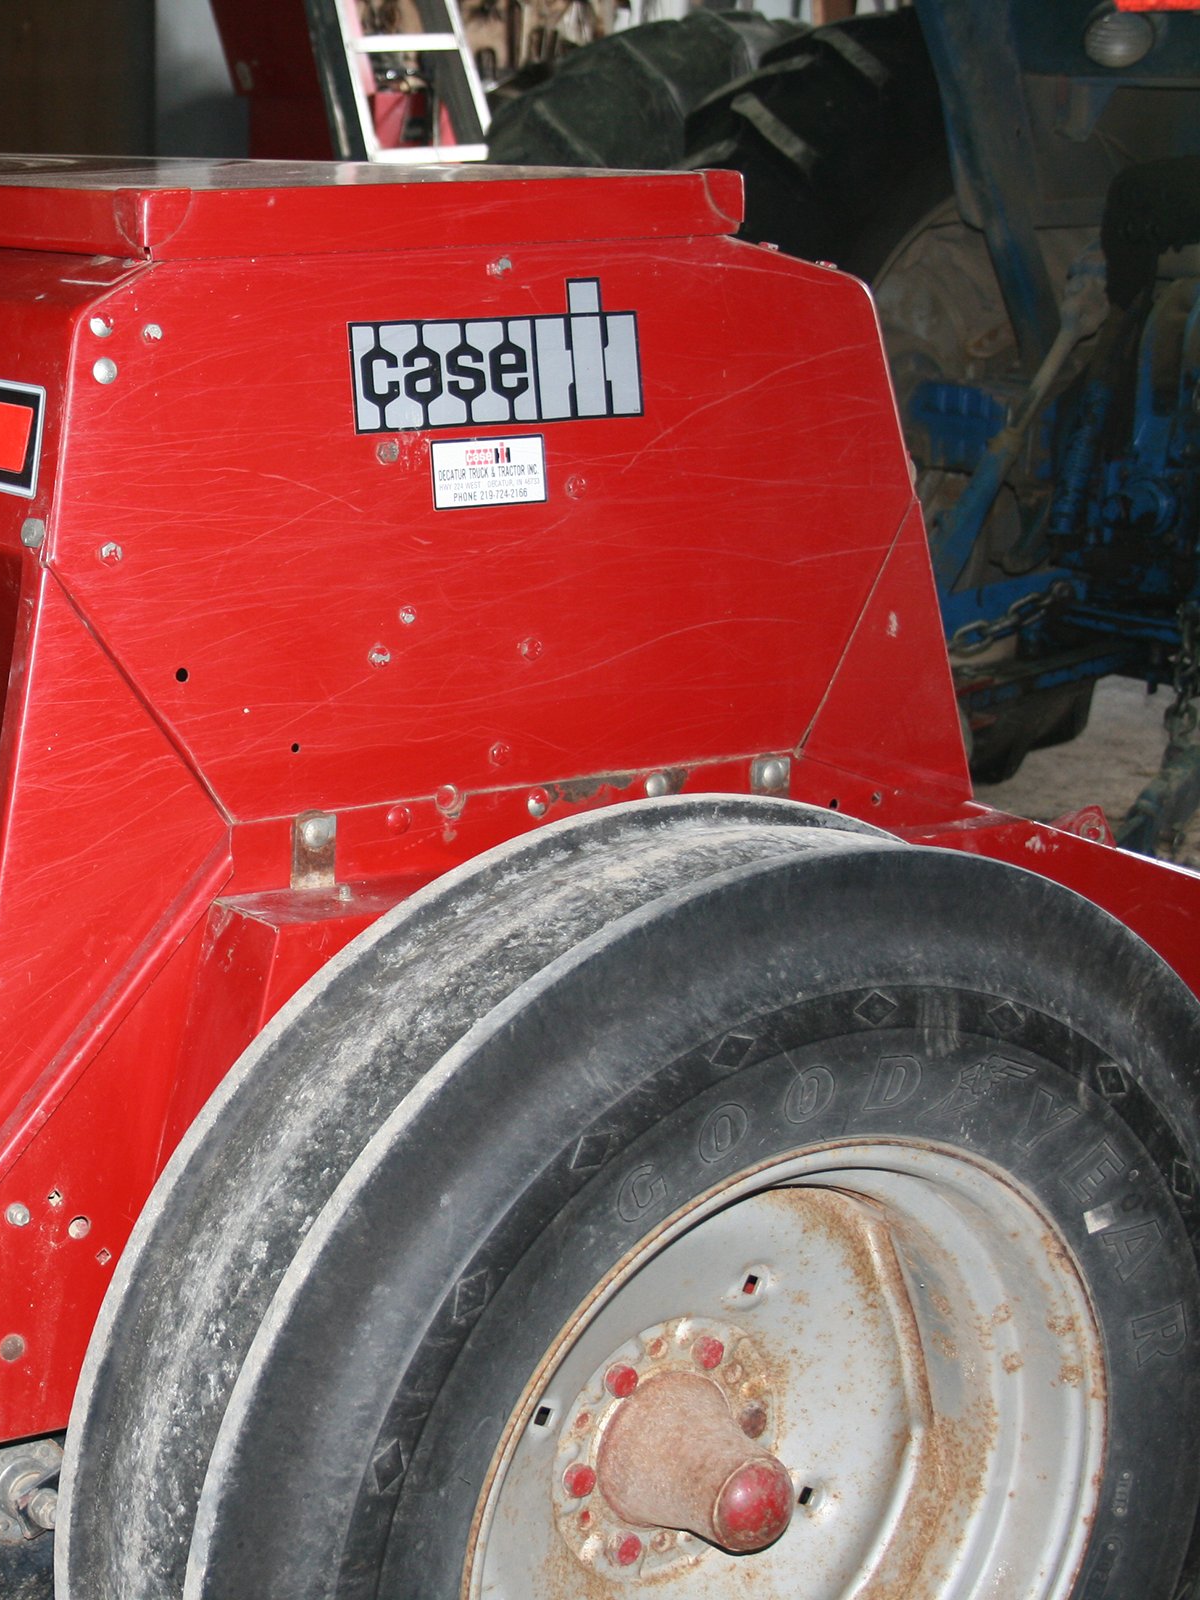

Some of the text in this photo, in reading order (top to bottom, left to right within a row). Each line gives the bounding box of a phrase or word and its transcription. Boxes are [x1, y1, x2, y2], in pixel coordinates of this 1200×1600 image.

[438, 463, 540, 481] DECATUR TRUCK & TRACTOR INC.
[438, 483, 452, 492] HWY
[453, 482, 464, 491] 224
[465, 481, 481, 490] WEST
[516, 478, 523, 486] IN
[453, 488, 528, 502] PHONE 219-724-2166
